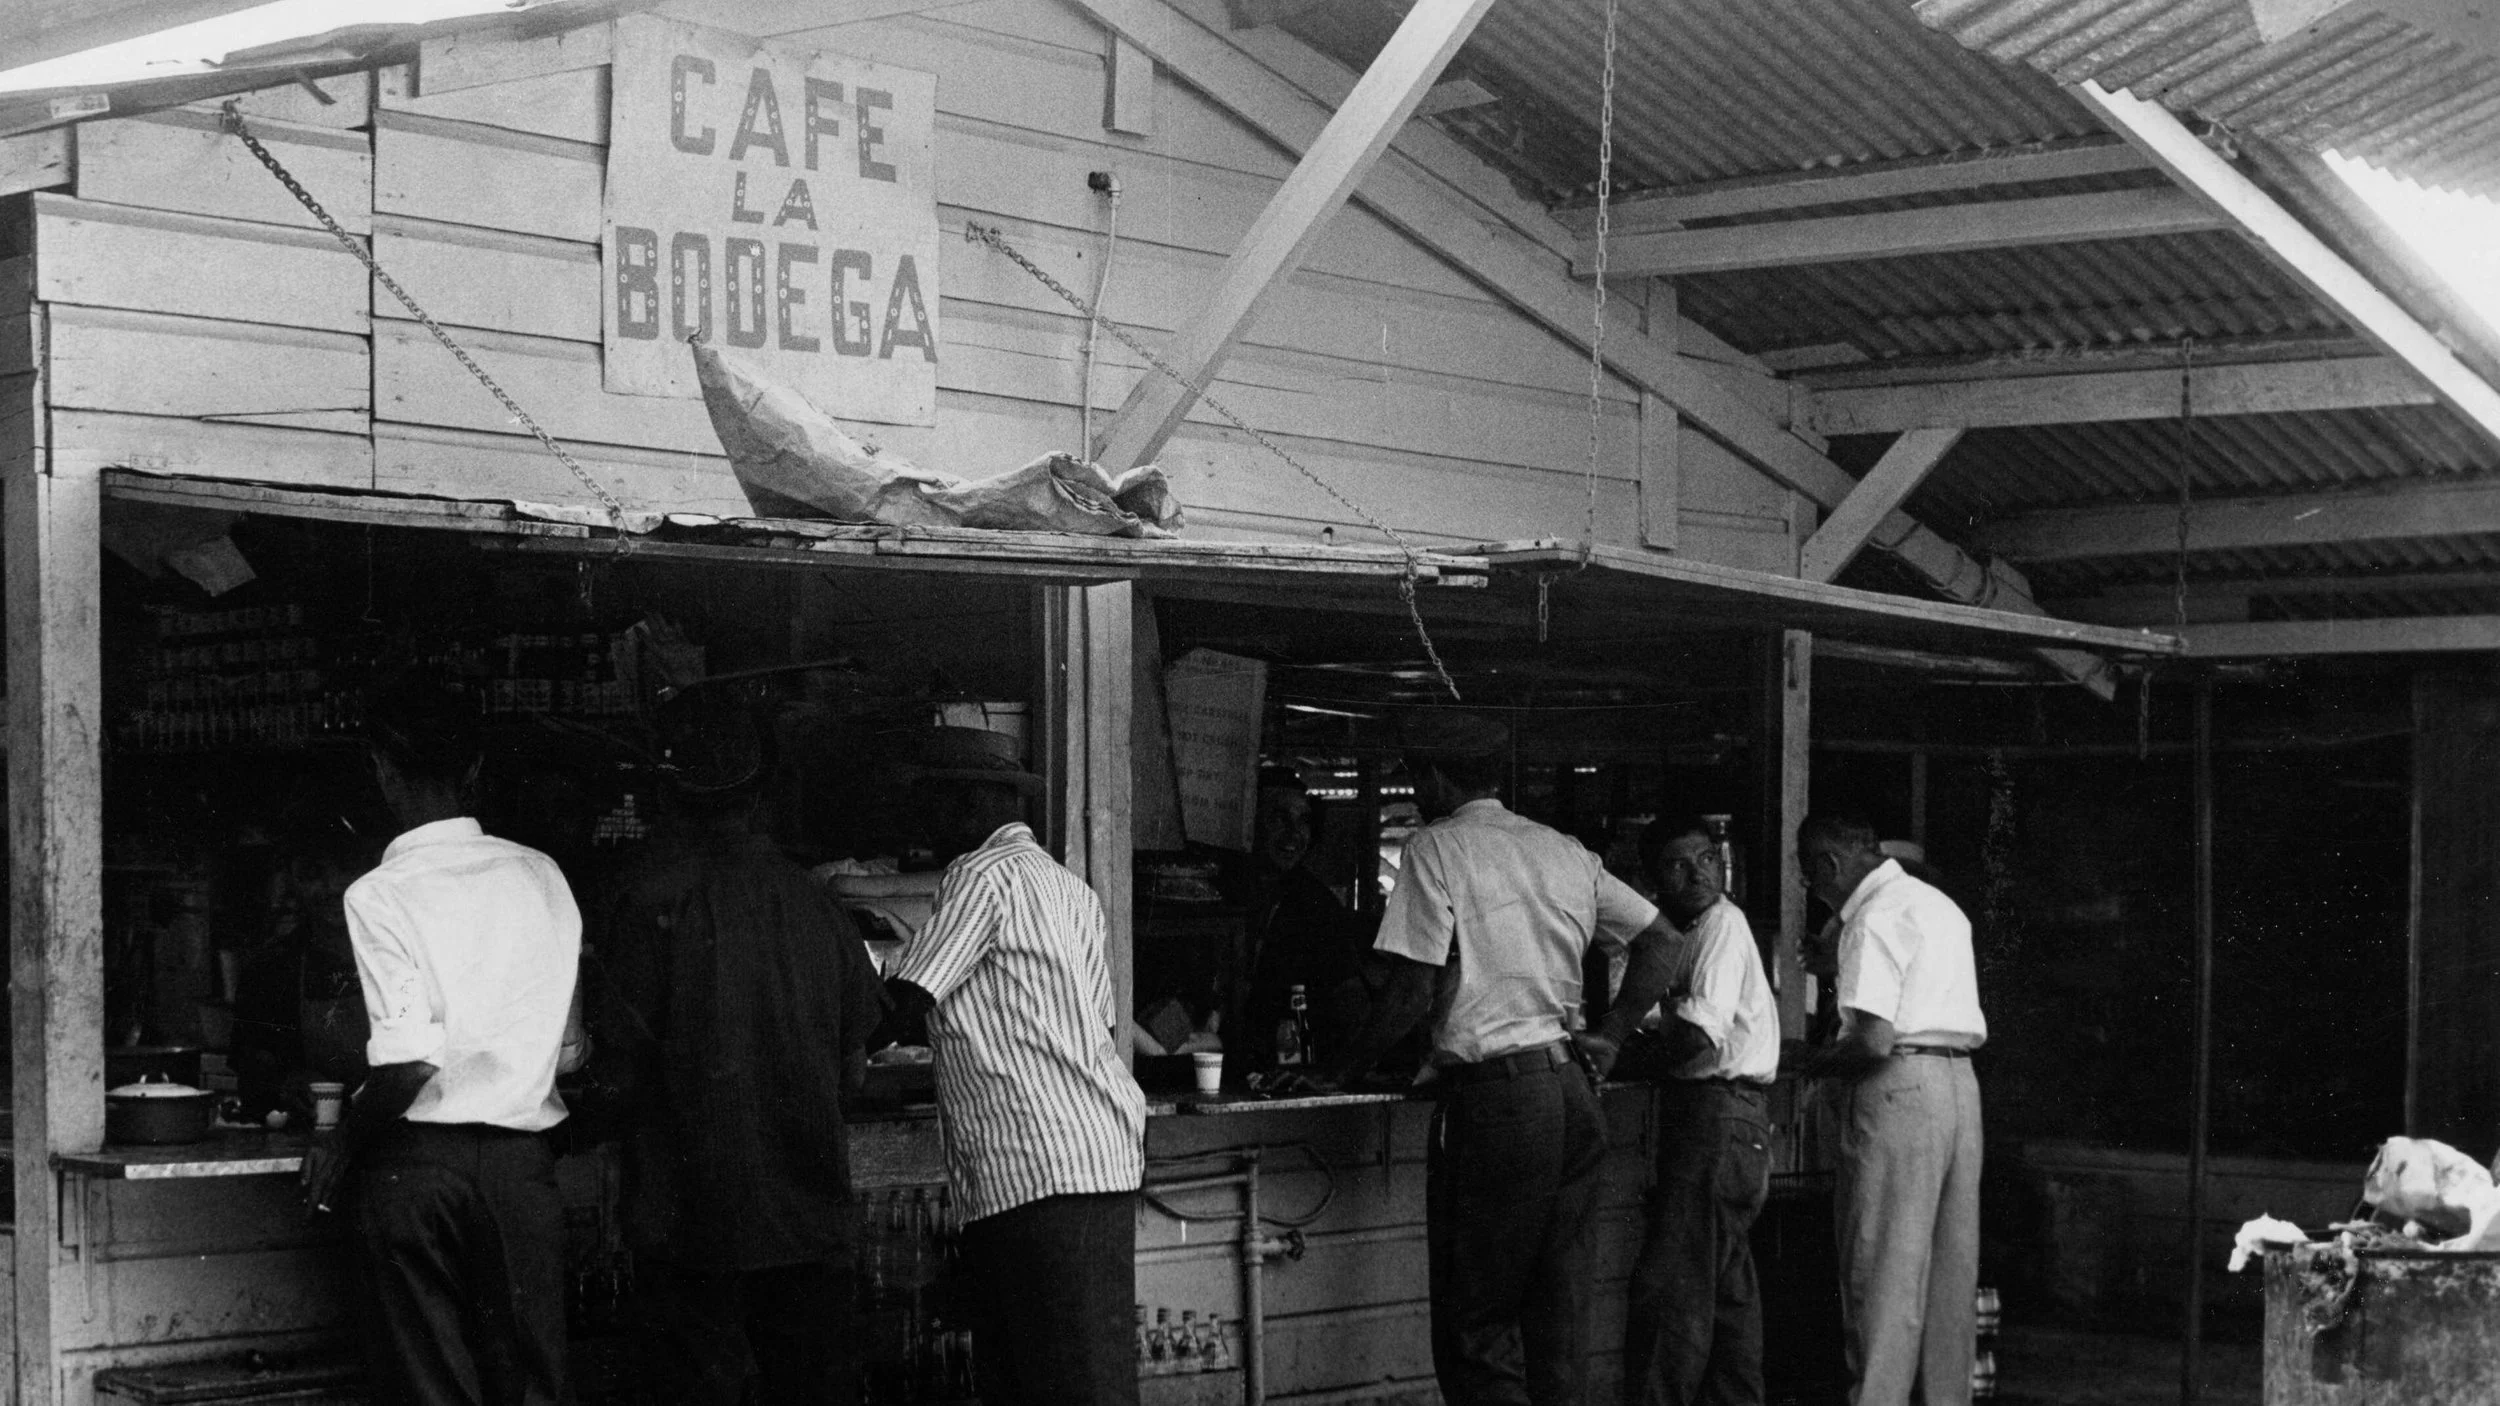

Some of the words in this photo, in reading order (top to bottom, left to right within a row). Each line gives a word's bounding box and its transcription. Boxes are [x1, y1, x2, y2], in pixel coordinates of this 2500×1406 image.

[671, 54, 896, 183] CAFE
[732, 170, 819, 231] LA
[615, 225, 938, 364] BODEGA
